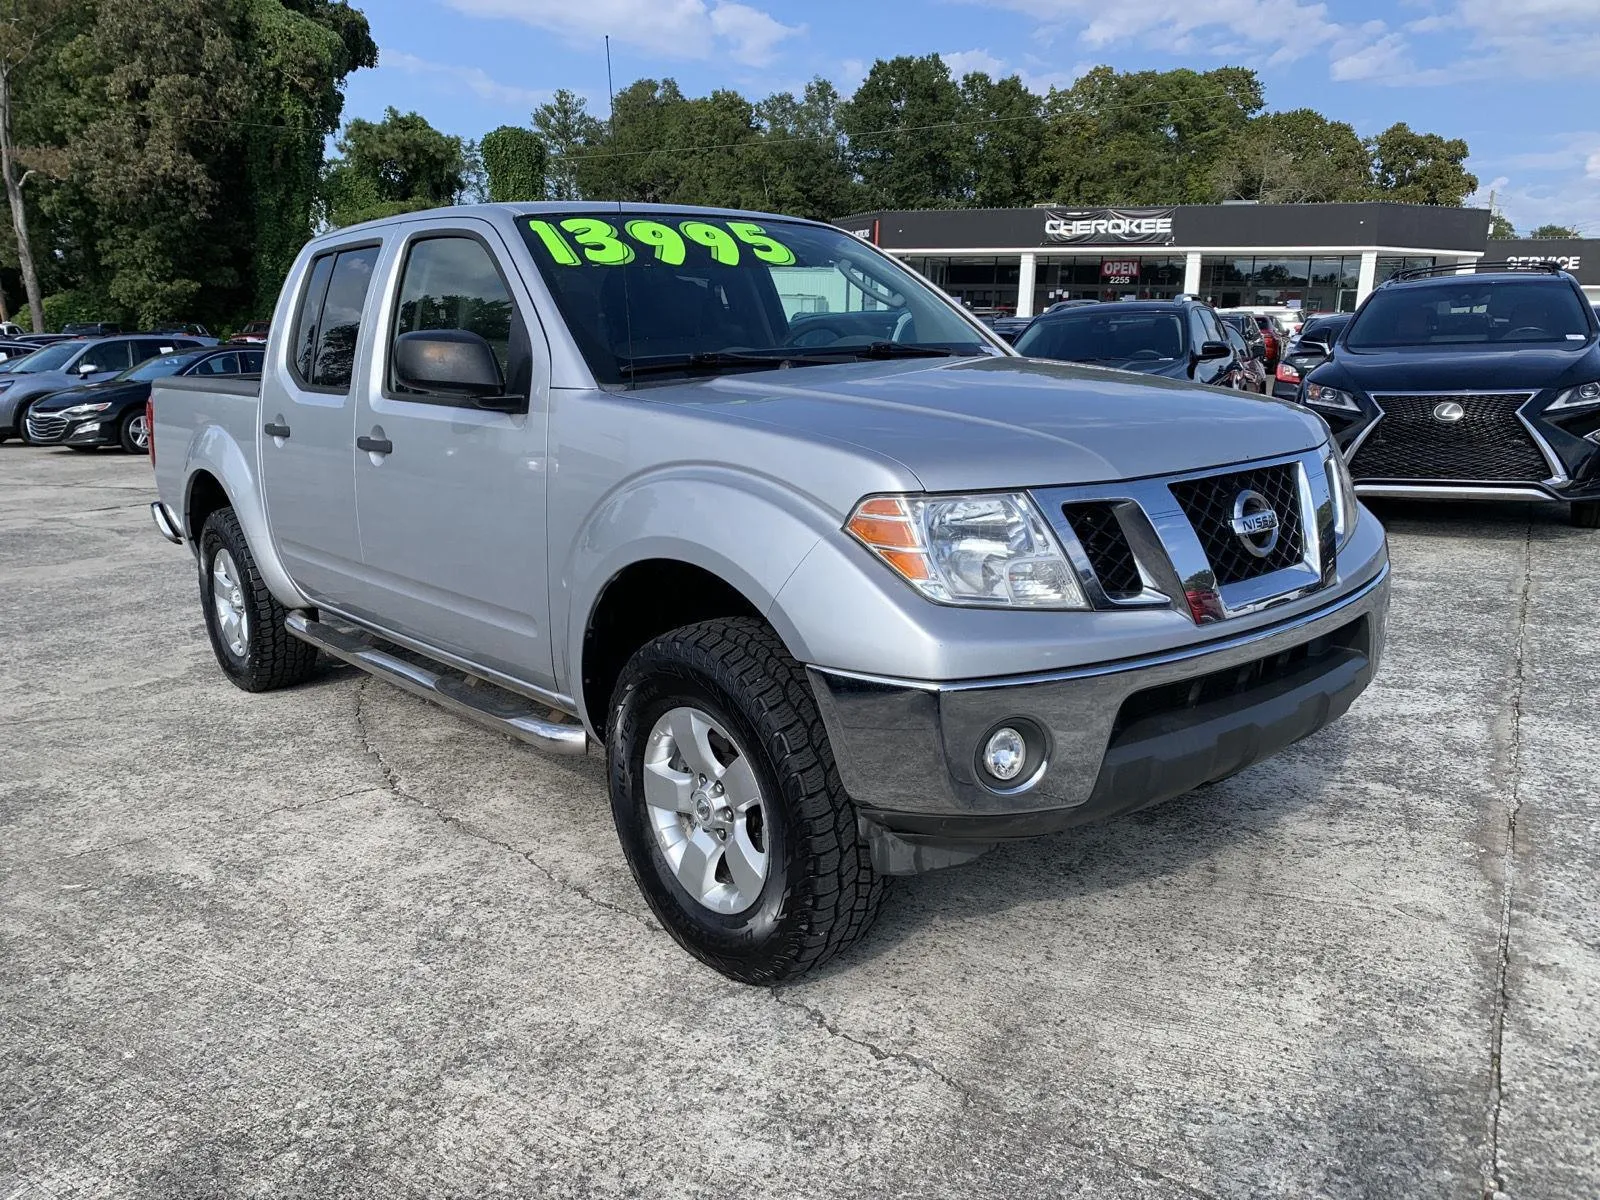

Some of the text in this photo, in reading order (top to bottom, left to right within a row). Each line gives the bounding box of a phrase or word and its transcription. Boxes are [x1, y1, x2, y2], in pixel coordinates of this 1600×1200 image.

[1045, 218, 1172, 234] CHEROKEE
[529, 218, 797, 265] 13995
[1104, 262, 1137, 274] OPEN
[1110, 276, 1130, 284] 2255
[1242, 513, 1277, 531] NISSA
